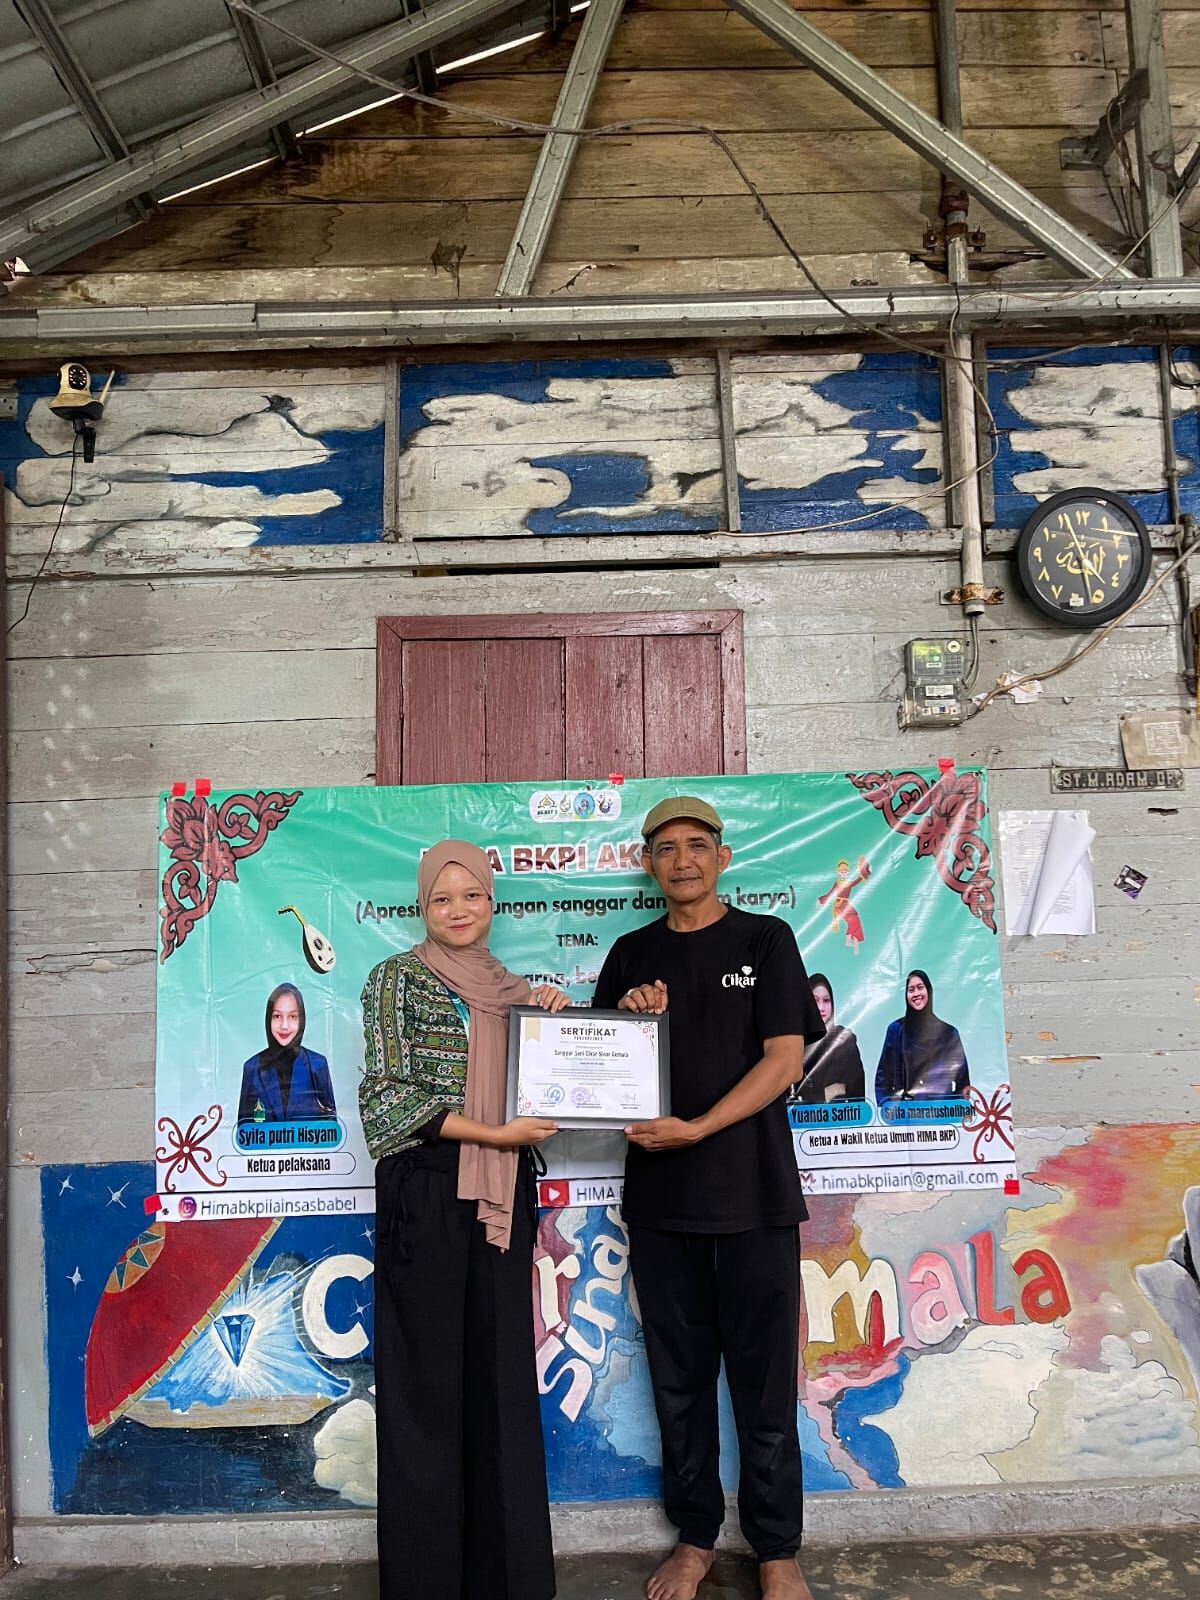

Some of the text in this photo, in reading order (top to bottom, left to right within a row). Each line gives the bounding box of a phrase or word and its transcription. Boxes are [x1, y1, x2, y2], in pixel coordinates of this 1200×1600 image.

[511, 844, 589, 873] BKPI
[355, 900, 421, 924] (Apresi
[552, 896, 627, 917] sanggar
[632, 891, 667, 910] dan
[736, 885, 796, 910] karya)
[555, 933, 599, 948] TEMA:
[722, 973, 757, 988] Cikar
[560, 1027, 617, 1037] SERTIFIKAT
[791, 1104, 861, 1124] Yuanda Safitri
[239, 1126, 337, 1146] Syifa putri Hisyam
[809, 1135, 832, 1148] Ketua
[840, 1132, 863, 1145] Wakil
[864, 1131, 888, 1145] Ketua
[890, 1131, 915, 1143] Umum
[916, 1130, 938, 1143] HIMA
[939, 1129, 957, 1142] BKPI
[247, 1157, 331, 1174] Ketua pelaksana
[821, 1171, 999, 1193] himabkpiiain@gmail.com
[576, 1186, 615, 1201] HIMA
[200, 1197, 357, 1217] Himabkpiiainsasbabel
